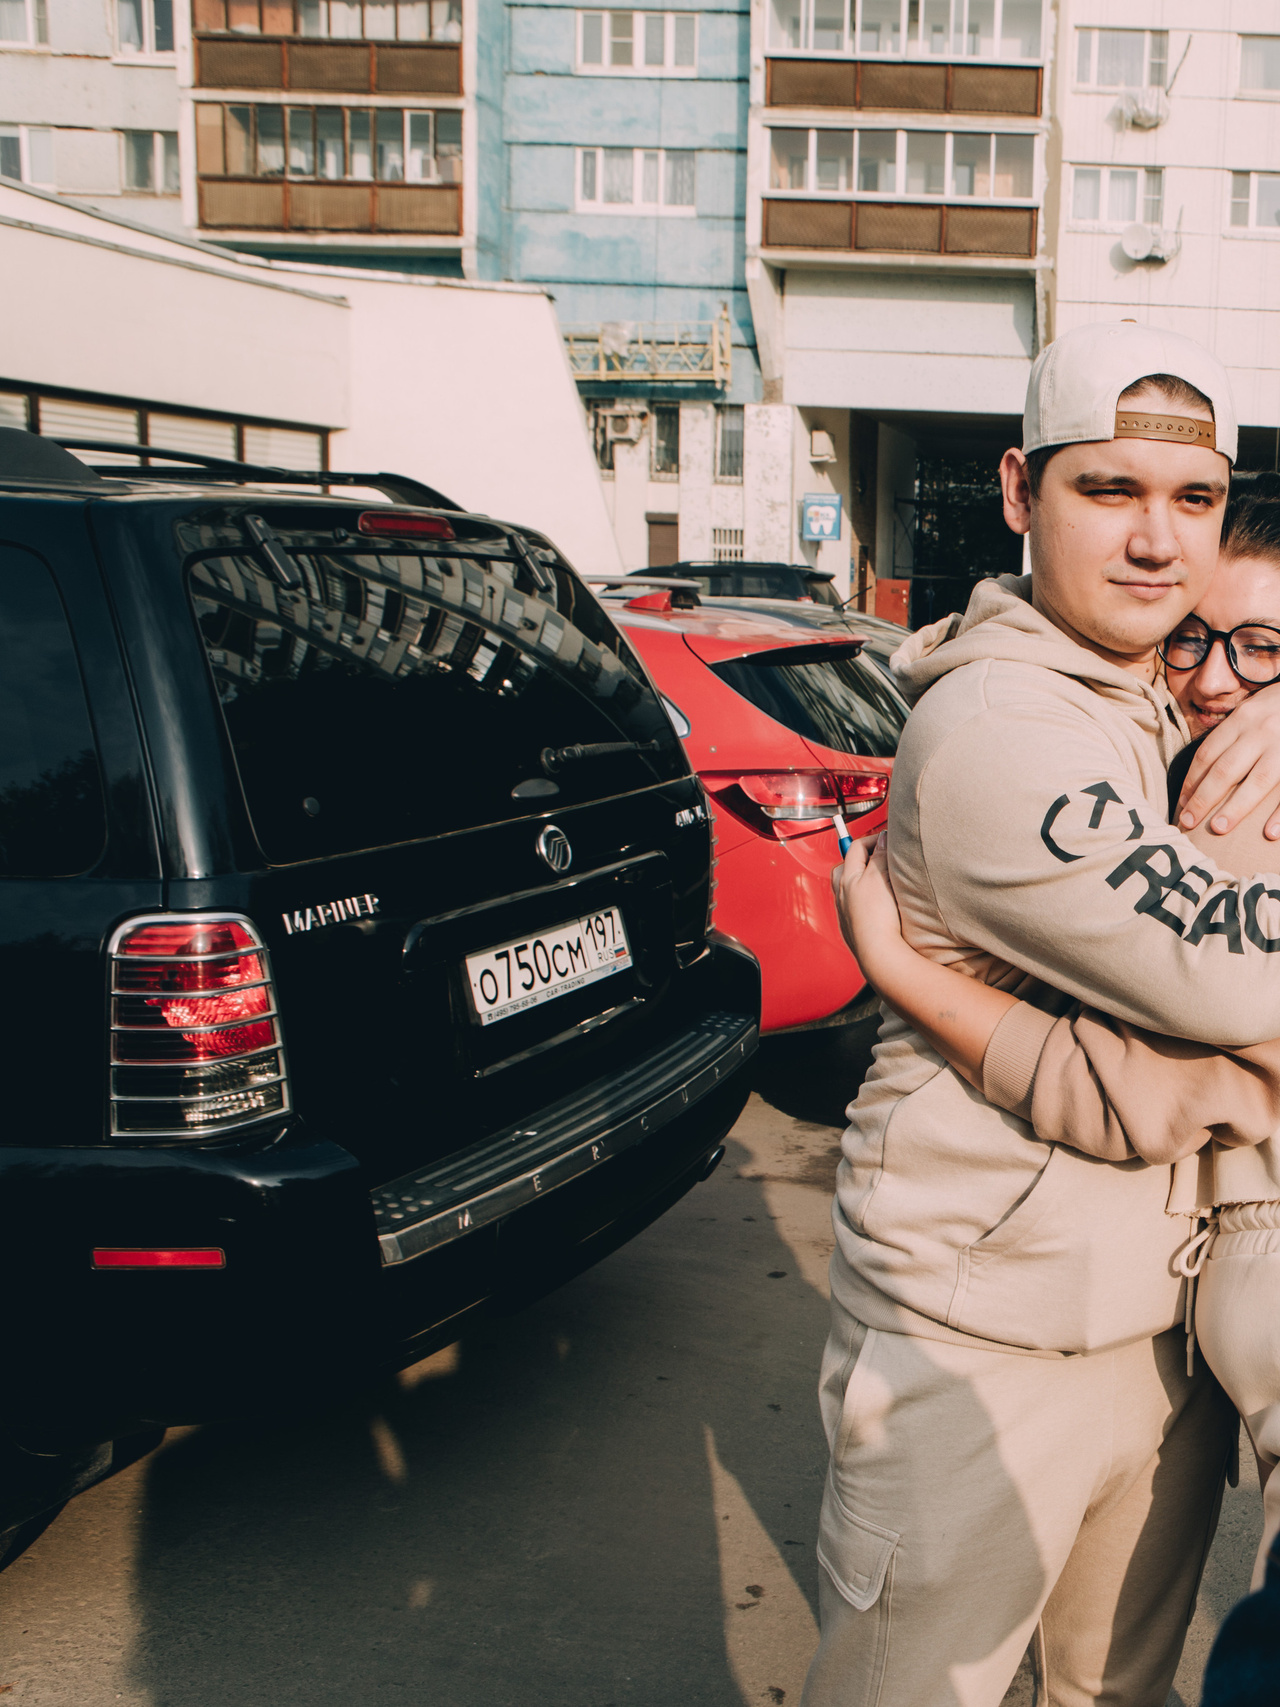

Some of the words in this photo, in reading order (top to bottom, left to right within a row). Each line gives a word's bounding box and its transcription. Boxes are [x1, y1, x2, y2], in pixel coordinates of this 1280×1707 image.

[281, 893, 381, 935] MARINER
[585, 911, 616, 951] 197
[597, 948, 614, 963] RUS
